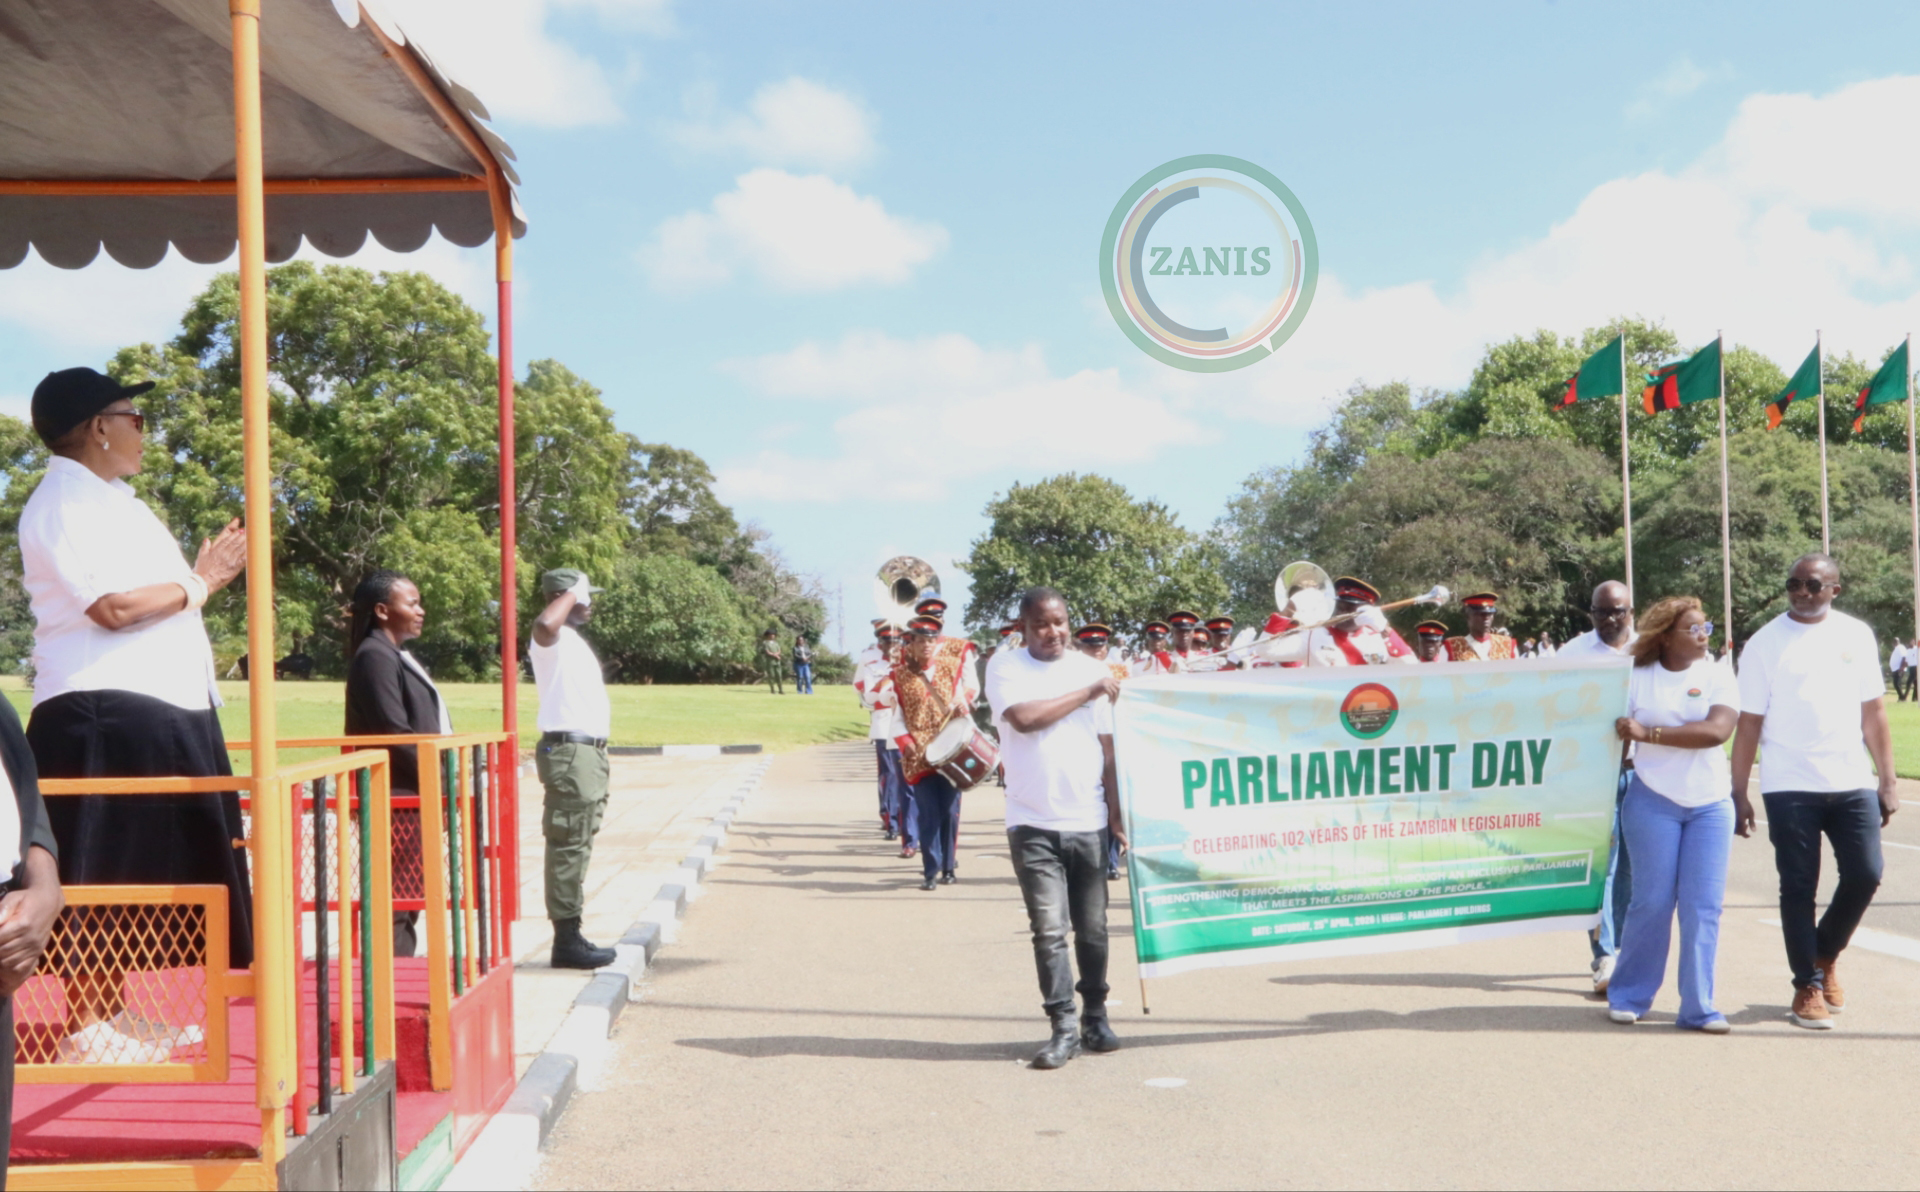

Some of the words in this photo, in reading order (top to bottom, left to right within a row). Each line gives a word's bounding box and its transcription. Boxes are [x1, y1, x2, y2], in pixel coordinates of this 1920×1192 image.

[1181, 743, 1456, 810] PARLIAMENT
[1472, 738, 1552, 789] DAY
[1193, 832, 1277, 854] CELEBRATING
[1281, 830, 1305, 847] 102
[1309, 826, 1348, 844] YEARS
[1353, 825, 1368, 841] OF
[1373, 823, 1395, 839] THE
[1400, 818, 1457, 837] ZAMBIAN
[1462, 812, 1542, 832] LEGISLATURE
[1242, 884, 1314, 897] DEMOCRATIC
[1394, 871, 1448, 885] THROUGH
[1449, 869, 1464, 880] AN
[1467, 865, 1520, 878] INCLUSIVE
[1522, 858, 1586, 873] PARLIAMENT
[1242, 902, 1269, 912] THAT
[1271, 898, 1308, 909] MEETS
[1310, 896, 1330, 906] THE
[1333, 889, 1402, 904] ASPIRATIONS
[1405, 888, 1420, 898] OF
[1422, 886, 1442, 896] THE
[1252, 926, 1272, 936] DATE:
[1408, 908, 1452, 920] PARLIAMENT
[1454, 904, 1491, 916] BUILDINGS
